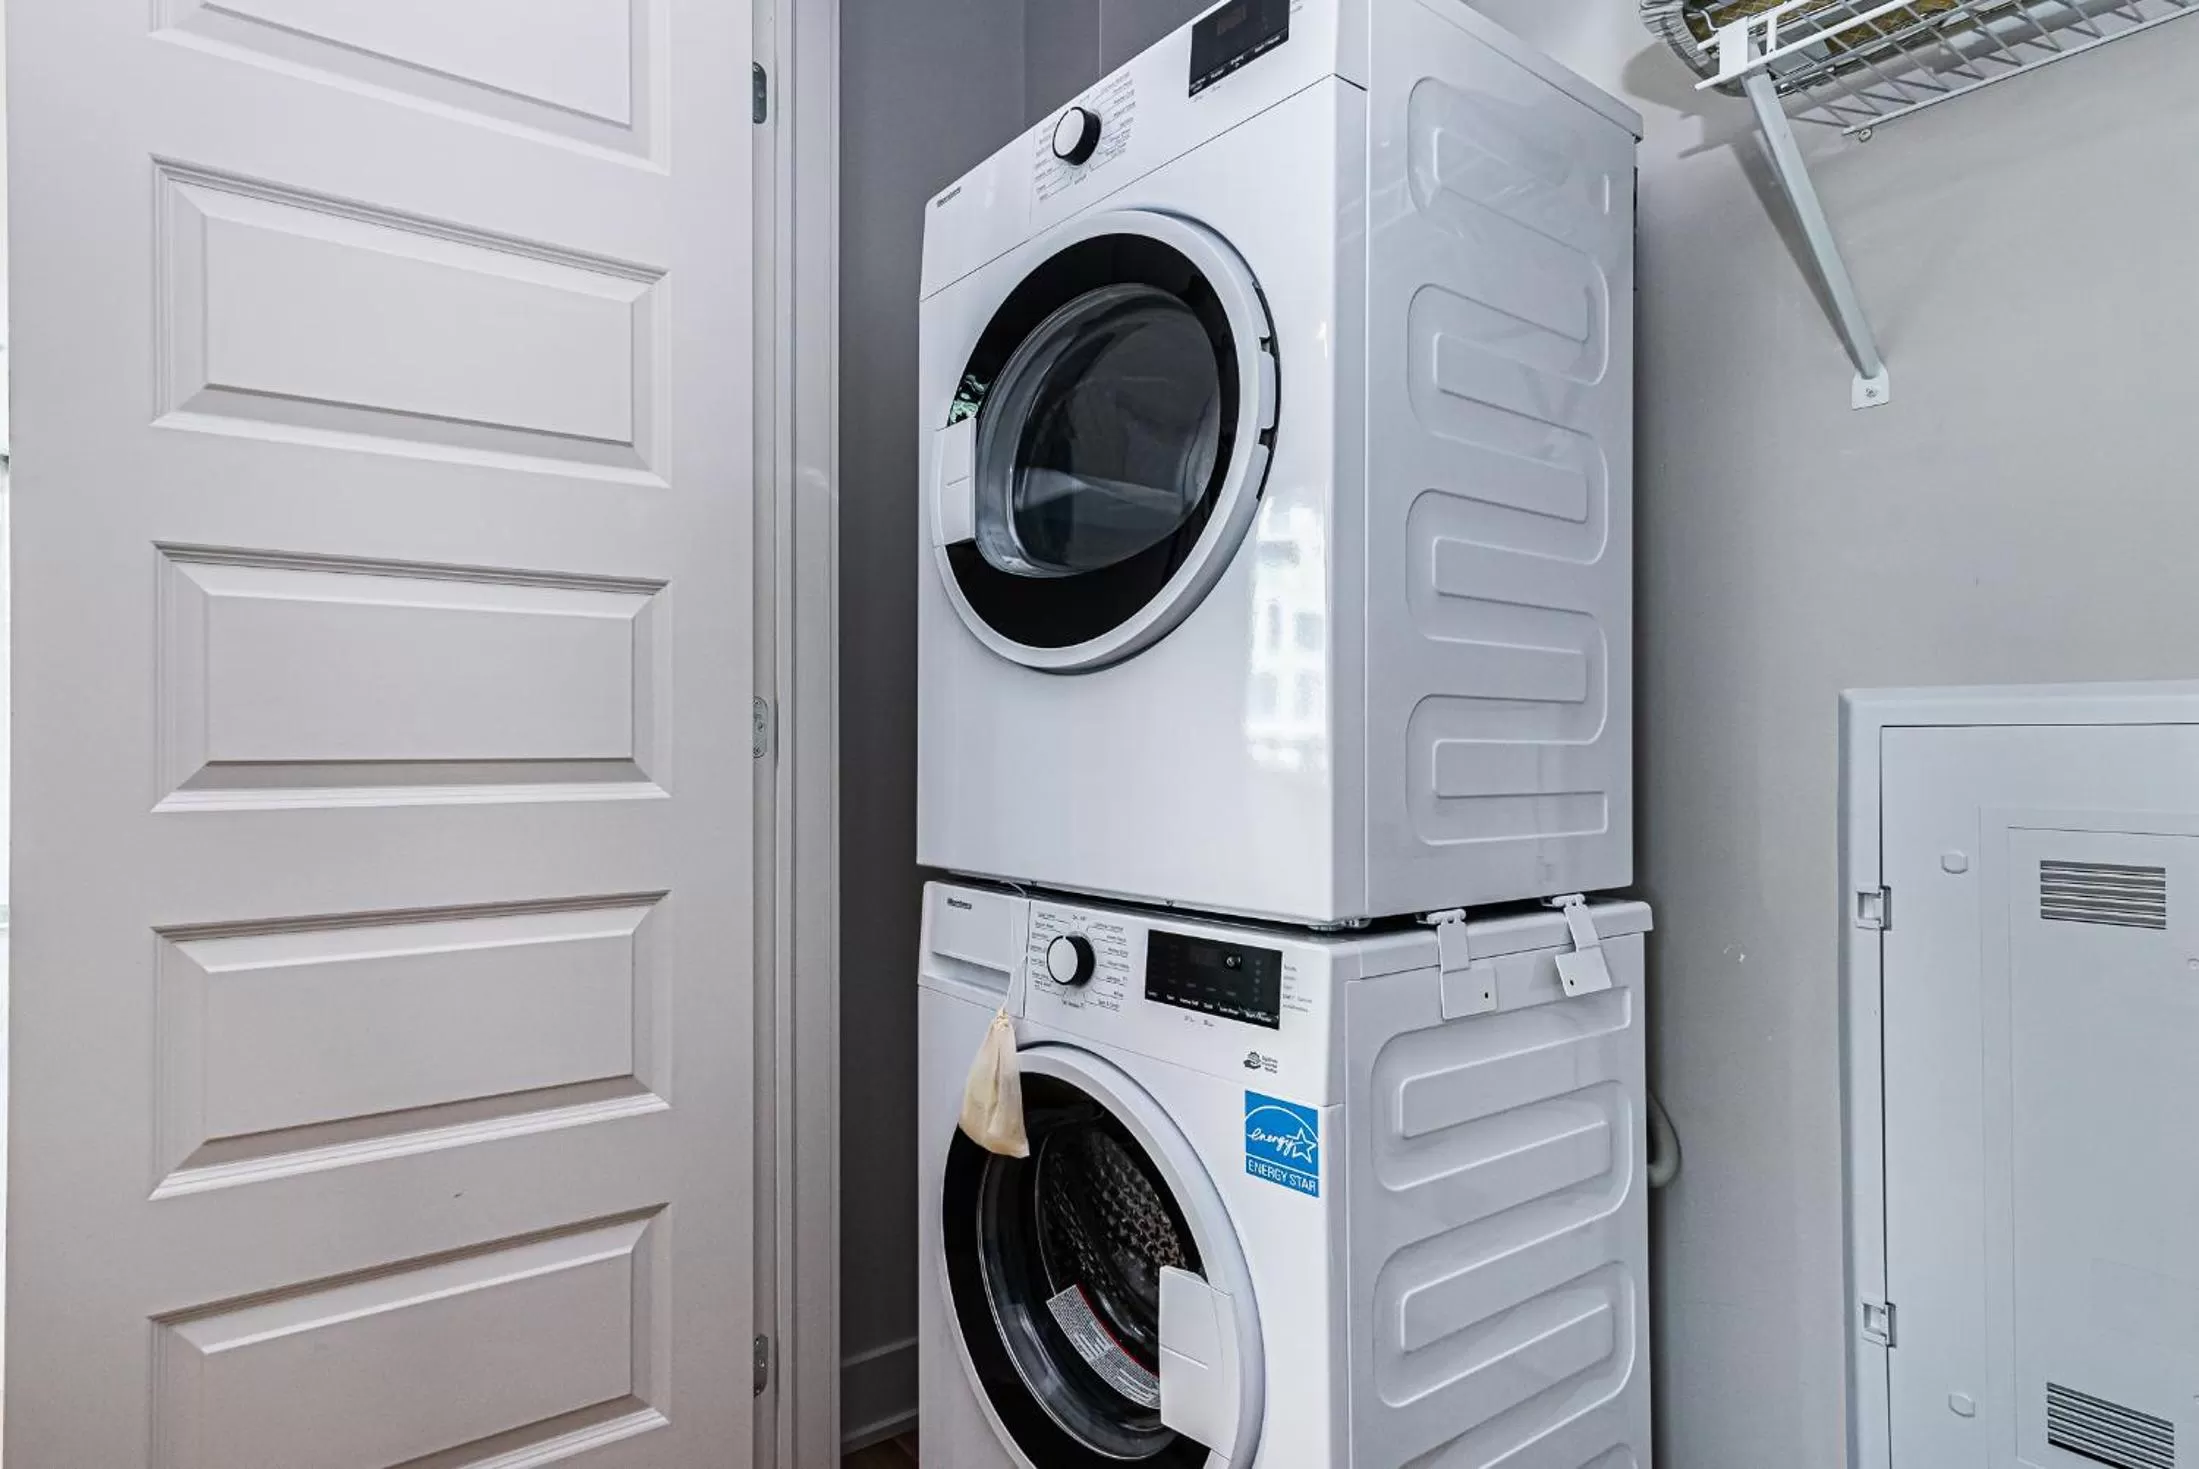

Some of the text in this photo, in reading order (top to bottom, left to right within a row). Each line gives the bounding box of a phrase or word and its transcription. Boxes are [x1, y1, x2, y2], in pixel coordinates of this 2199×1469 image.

[1248, 1127, 1298, 1156] energy
[1248, 1159, 1316, 1193] ENERGY STAR
